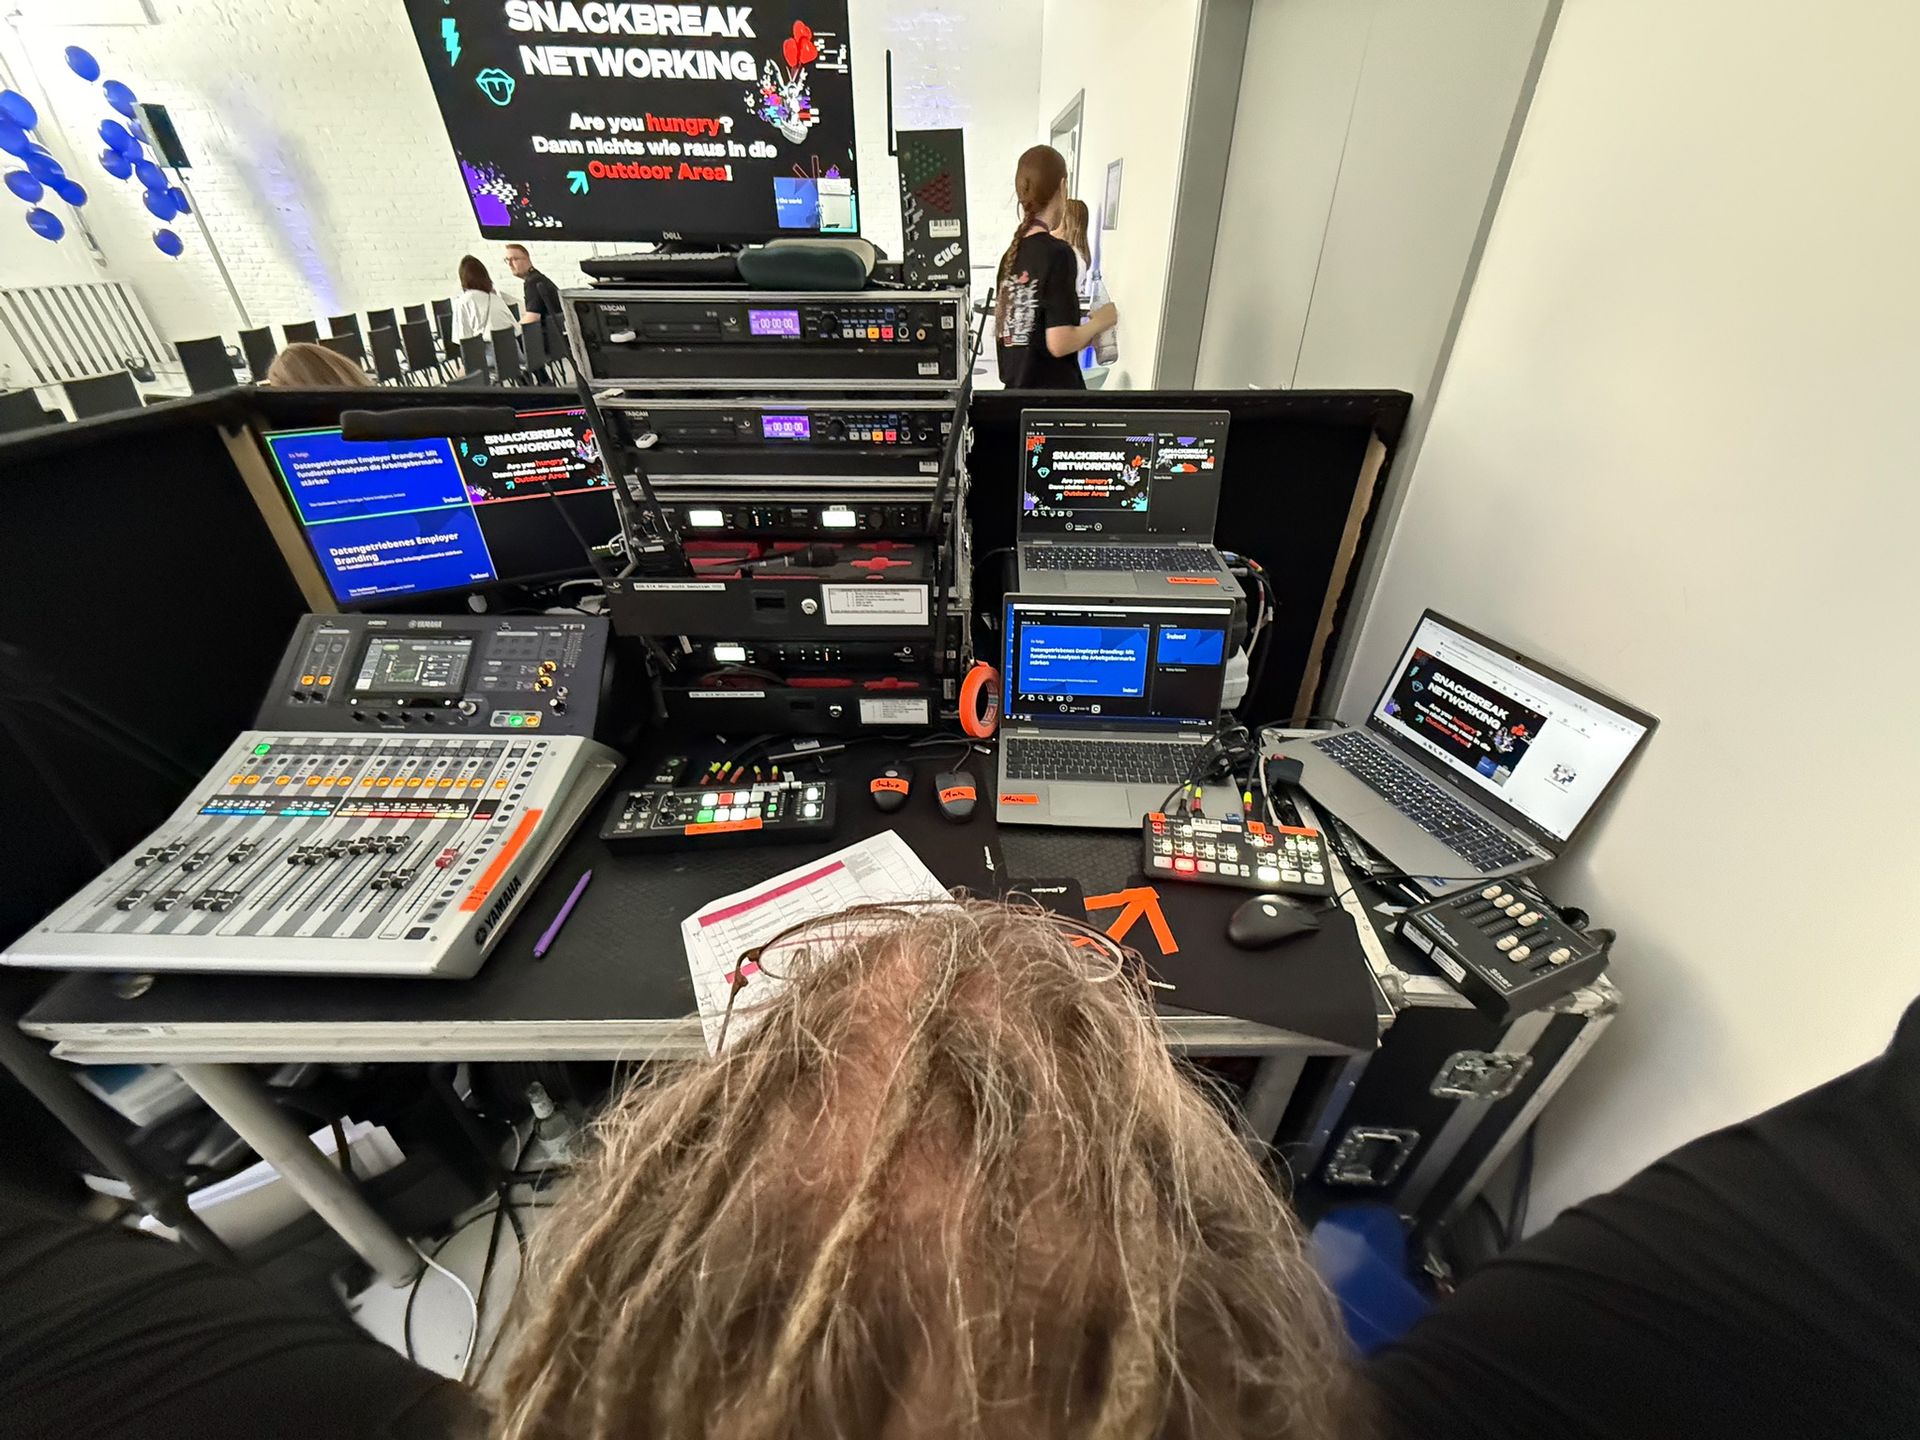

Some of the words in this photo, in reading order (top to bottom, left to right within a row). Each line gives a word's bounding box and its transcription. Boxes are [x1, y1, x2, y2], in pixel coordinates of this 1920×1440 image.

[504, 0, 757, 38] SNACKBREAK
[518, 45, 758, 81] NETWORKING
[570, 113, 608, 131] Are
[610, 116, 645, 134] you
[646, 113, 734, 136] hungry?
[532, 136, 584, 155] Dann
[588, 137, 645, 156] nichts
[647, 139, 683, 157] wie
[684, 142, 726, 157] raus
[728, 140, 747, 158] in
[749, 141, 778, 158] die
[588, 161, 673, 180] Outdoor
[934, 242, 962, 267] cue
[600, 304, 626, 312] TASCAM
[484, 427, 574, 445] SNACKBREAK
[488, 439, 576, 456] NETWORKING
[1052, 451, 1125, 460] SNACKBREAK
[358, 454, 391, 465] Employer
[1052, 461, 1123, 471] NETWORKING
[329, 538, 416, 557] Datengetriebenes
[416, 532, 459, 546] Employer
[333, 552, 379, 567] Branding
[1427, 682, 1502, 730] NETWORKING
[1432, 672, 1510, 720] SNACKBREAK
[484, 875, 523, 930] YAMAHA
